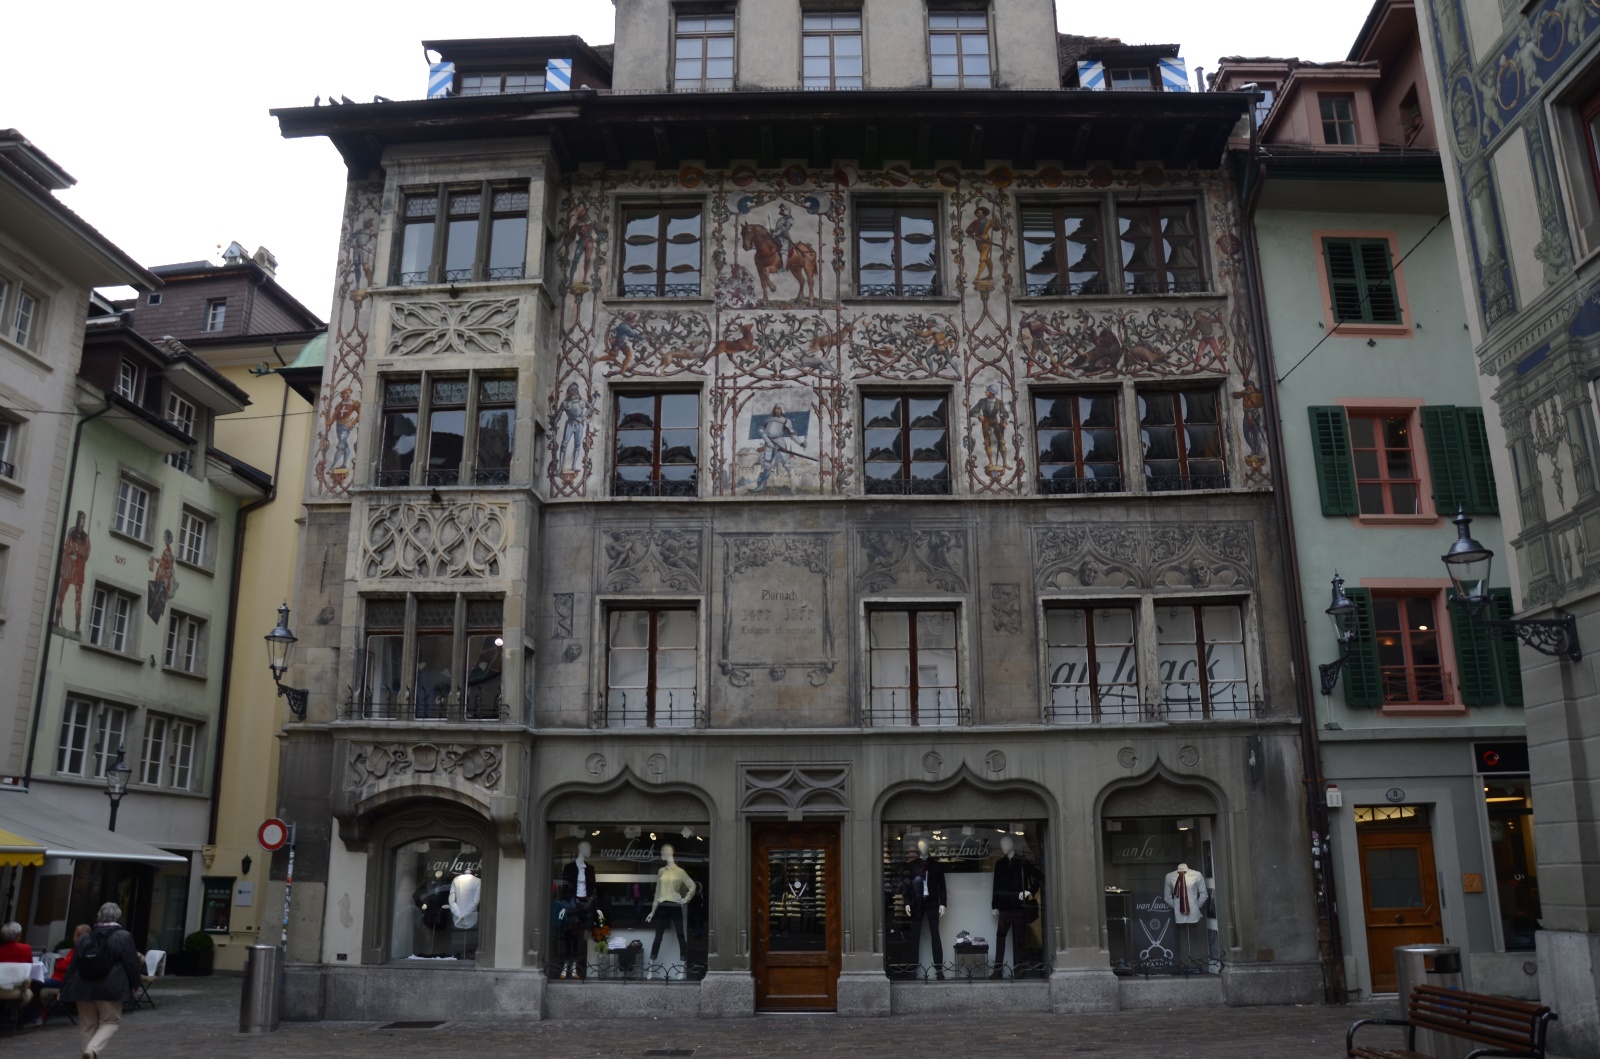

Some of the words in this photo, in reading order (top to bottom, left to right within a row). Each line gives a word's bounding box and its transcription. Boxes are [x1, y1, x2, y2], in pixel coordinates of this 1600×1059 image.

[761, 589, 798, 601] Dornach
[1049, 661, 1101, 690] an
[600, 848, 622, 858] van
[616, 838, 672, 863] Laack
[934, 846, 956, 857] van
[951, 836, 1007, 860] Laack
[426, 862, 449, 871] van
[1147, 896, 1172, 912] Laac
